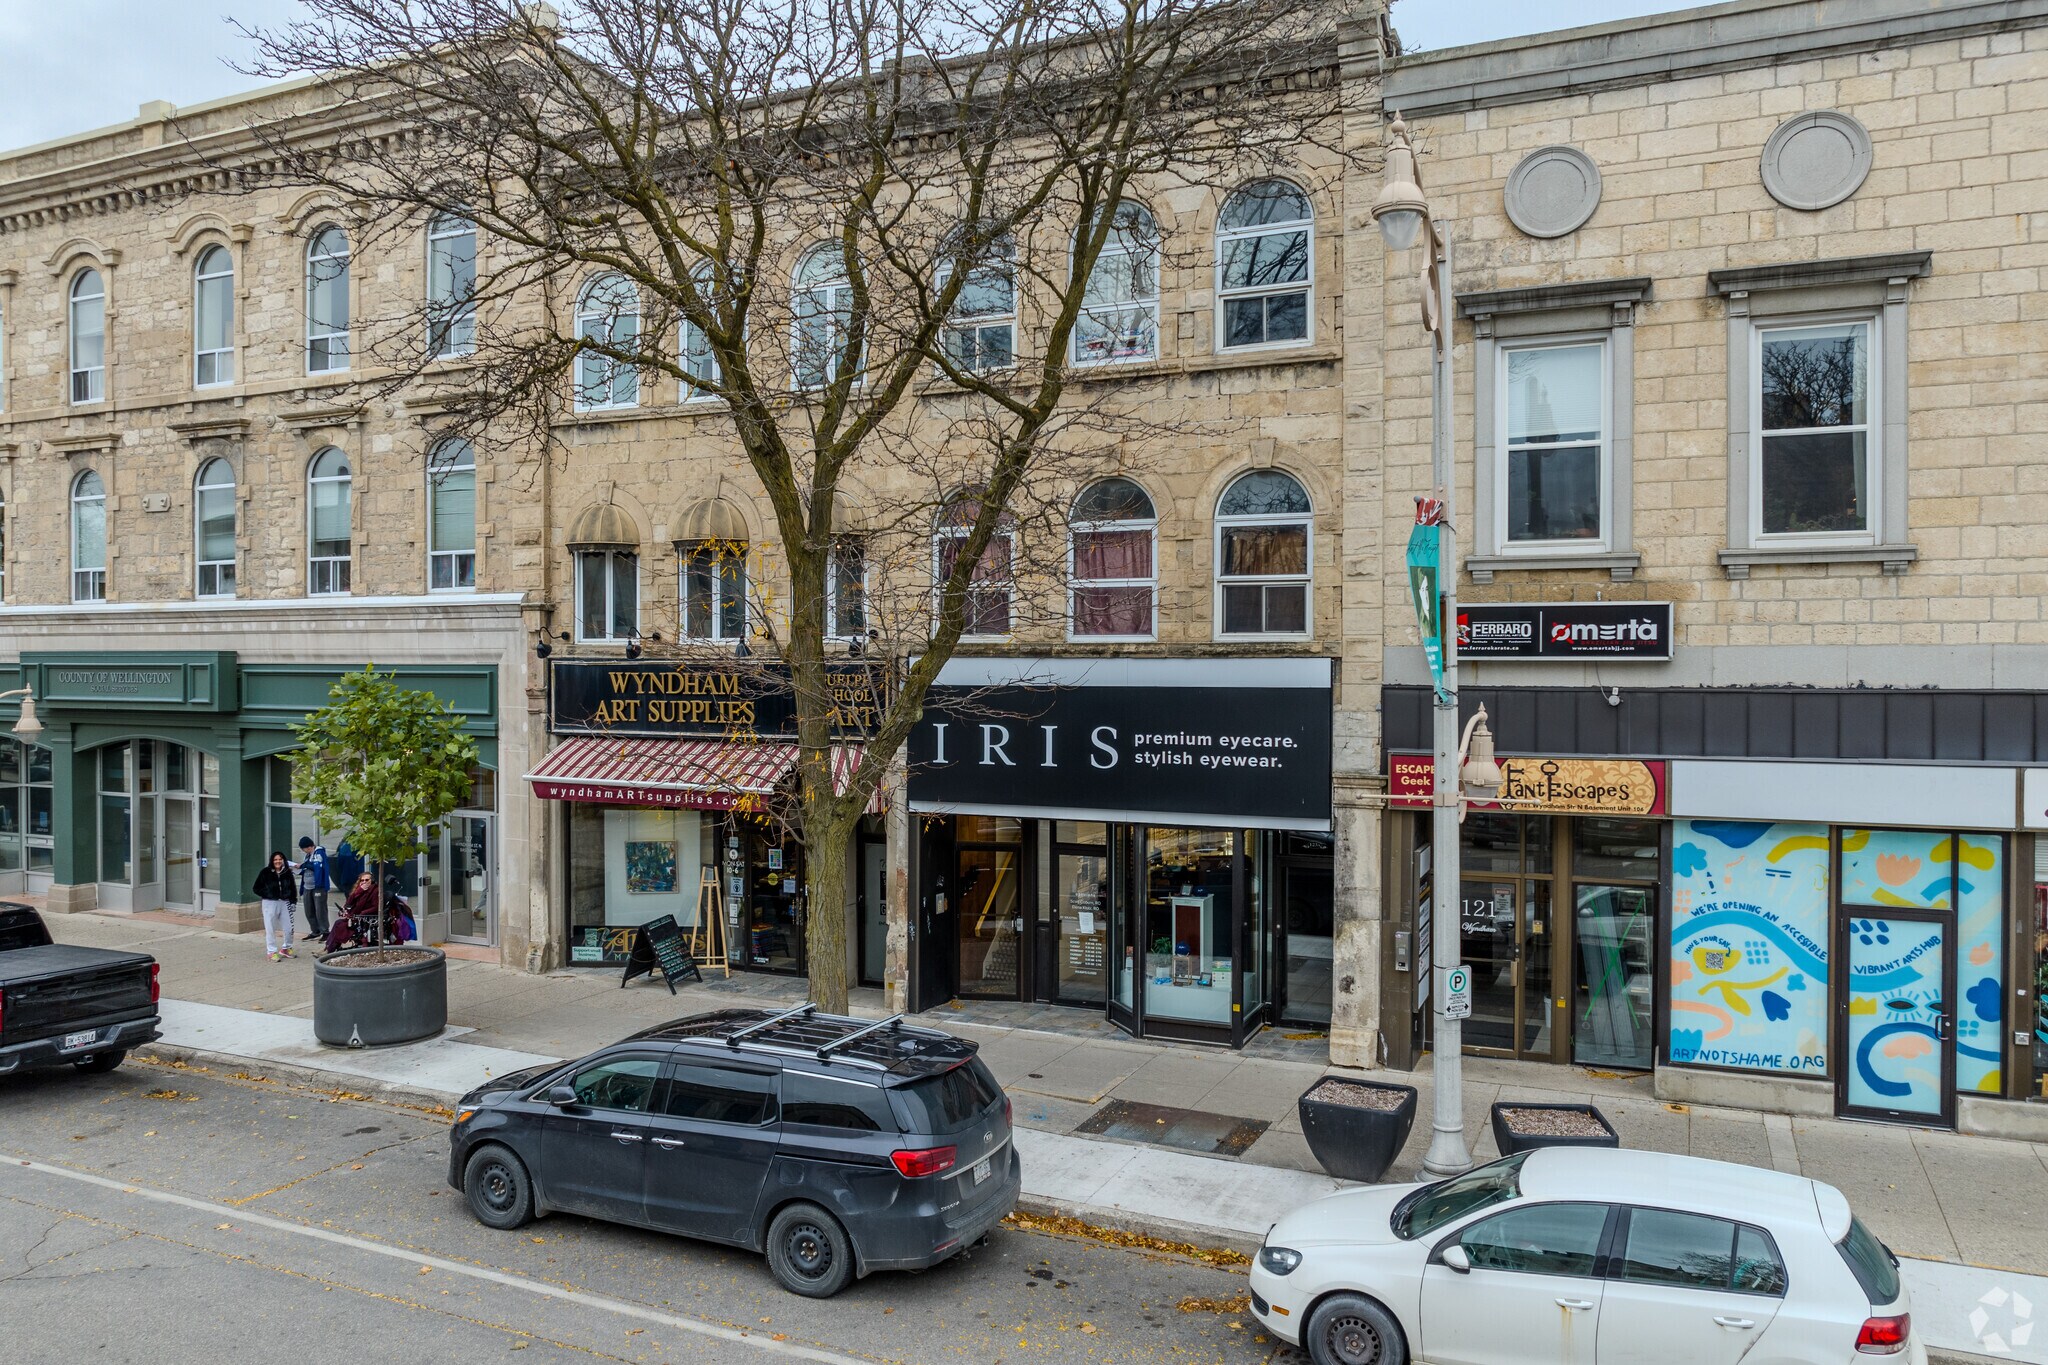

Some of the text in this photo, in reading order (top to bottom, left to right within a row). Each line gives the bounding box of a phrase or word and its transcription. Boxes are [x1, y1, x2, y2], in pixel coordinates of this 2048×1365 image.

[1472, 623, 1532, 637] FERRARO
[1551, 617, 1658, 643] omertà
[59, 671, 172, 684] COUNTY OF WELLINGTON
[608, 671, 741, 695] WYNDHAM
[594, 700, 756, 724] ART SUPPLIES
[932, 723, 1118, 770] IRIS
[1134, 731, 1298, 750] premium eyecare.
[1135, 750, 1283, 769] stylish eyewear.
[1396, 764, 1435, 774] ESCAPE
[1401, 776, 1431, 786] Geek
[1462, 899, 1496, 918] 121
[1462, 922, 1497, 934] Wyndham
[1691, 901, 1828, 960] WE'RE OPENING AN ACCESSIBLE
[1684, 939, 1699, 954] HAVE
[1718, 938, 1731, 948] SAY
[1854, 935, 1941, 974] VIBRANT ARTS HUB
[1454, 975, 1463, 988] P
[1673, 1048, 1825, 1069] ARTNOTSHAME.ORG
